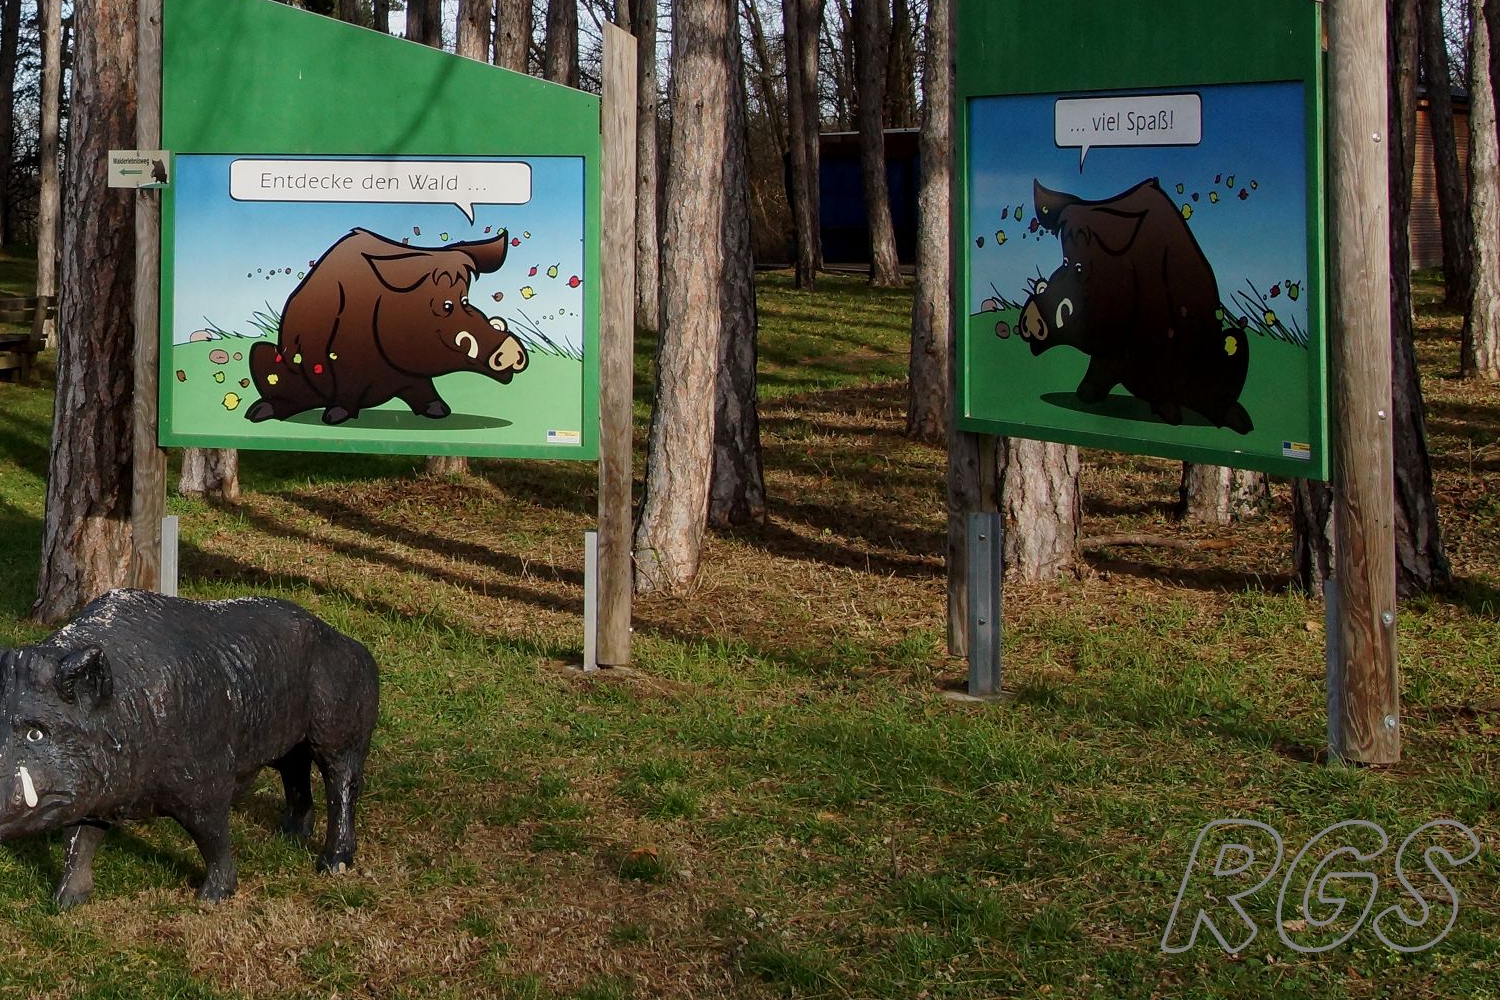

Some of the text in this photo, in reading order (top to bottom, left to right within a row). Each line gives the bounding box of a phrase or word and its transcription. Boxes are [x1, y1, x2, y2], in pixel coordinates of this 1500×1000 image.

[1092, 112, 1120, 131] viel
[1126, 110, 1173, 136] Spaß!
[260, 172, 353, 190] Entdecke
[361, 173, 400, 190] den
[407, 174, 458, 191] Wald
